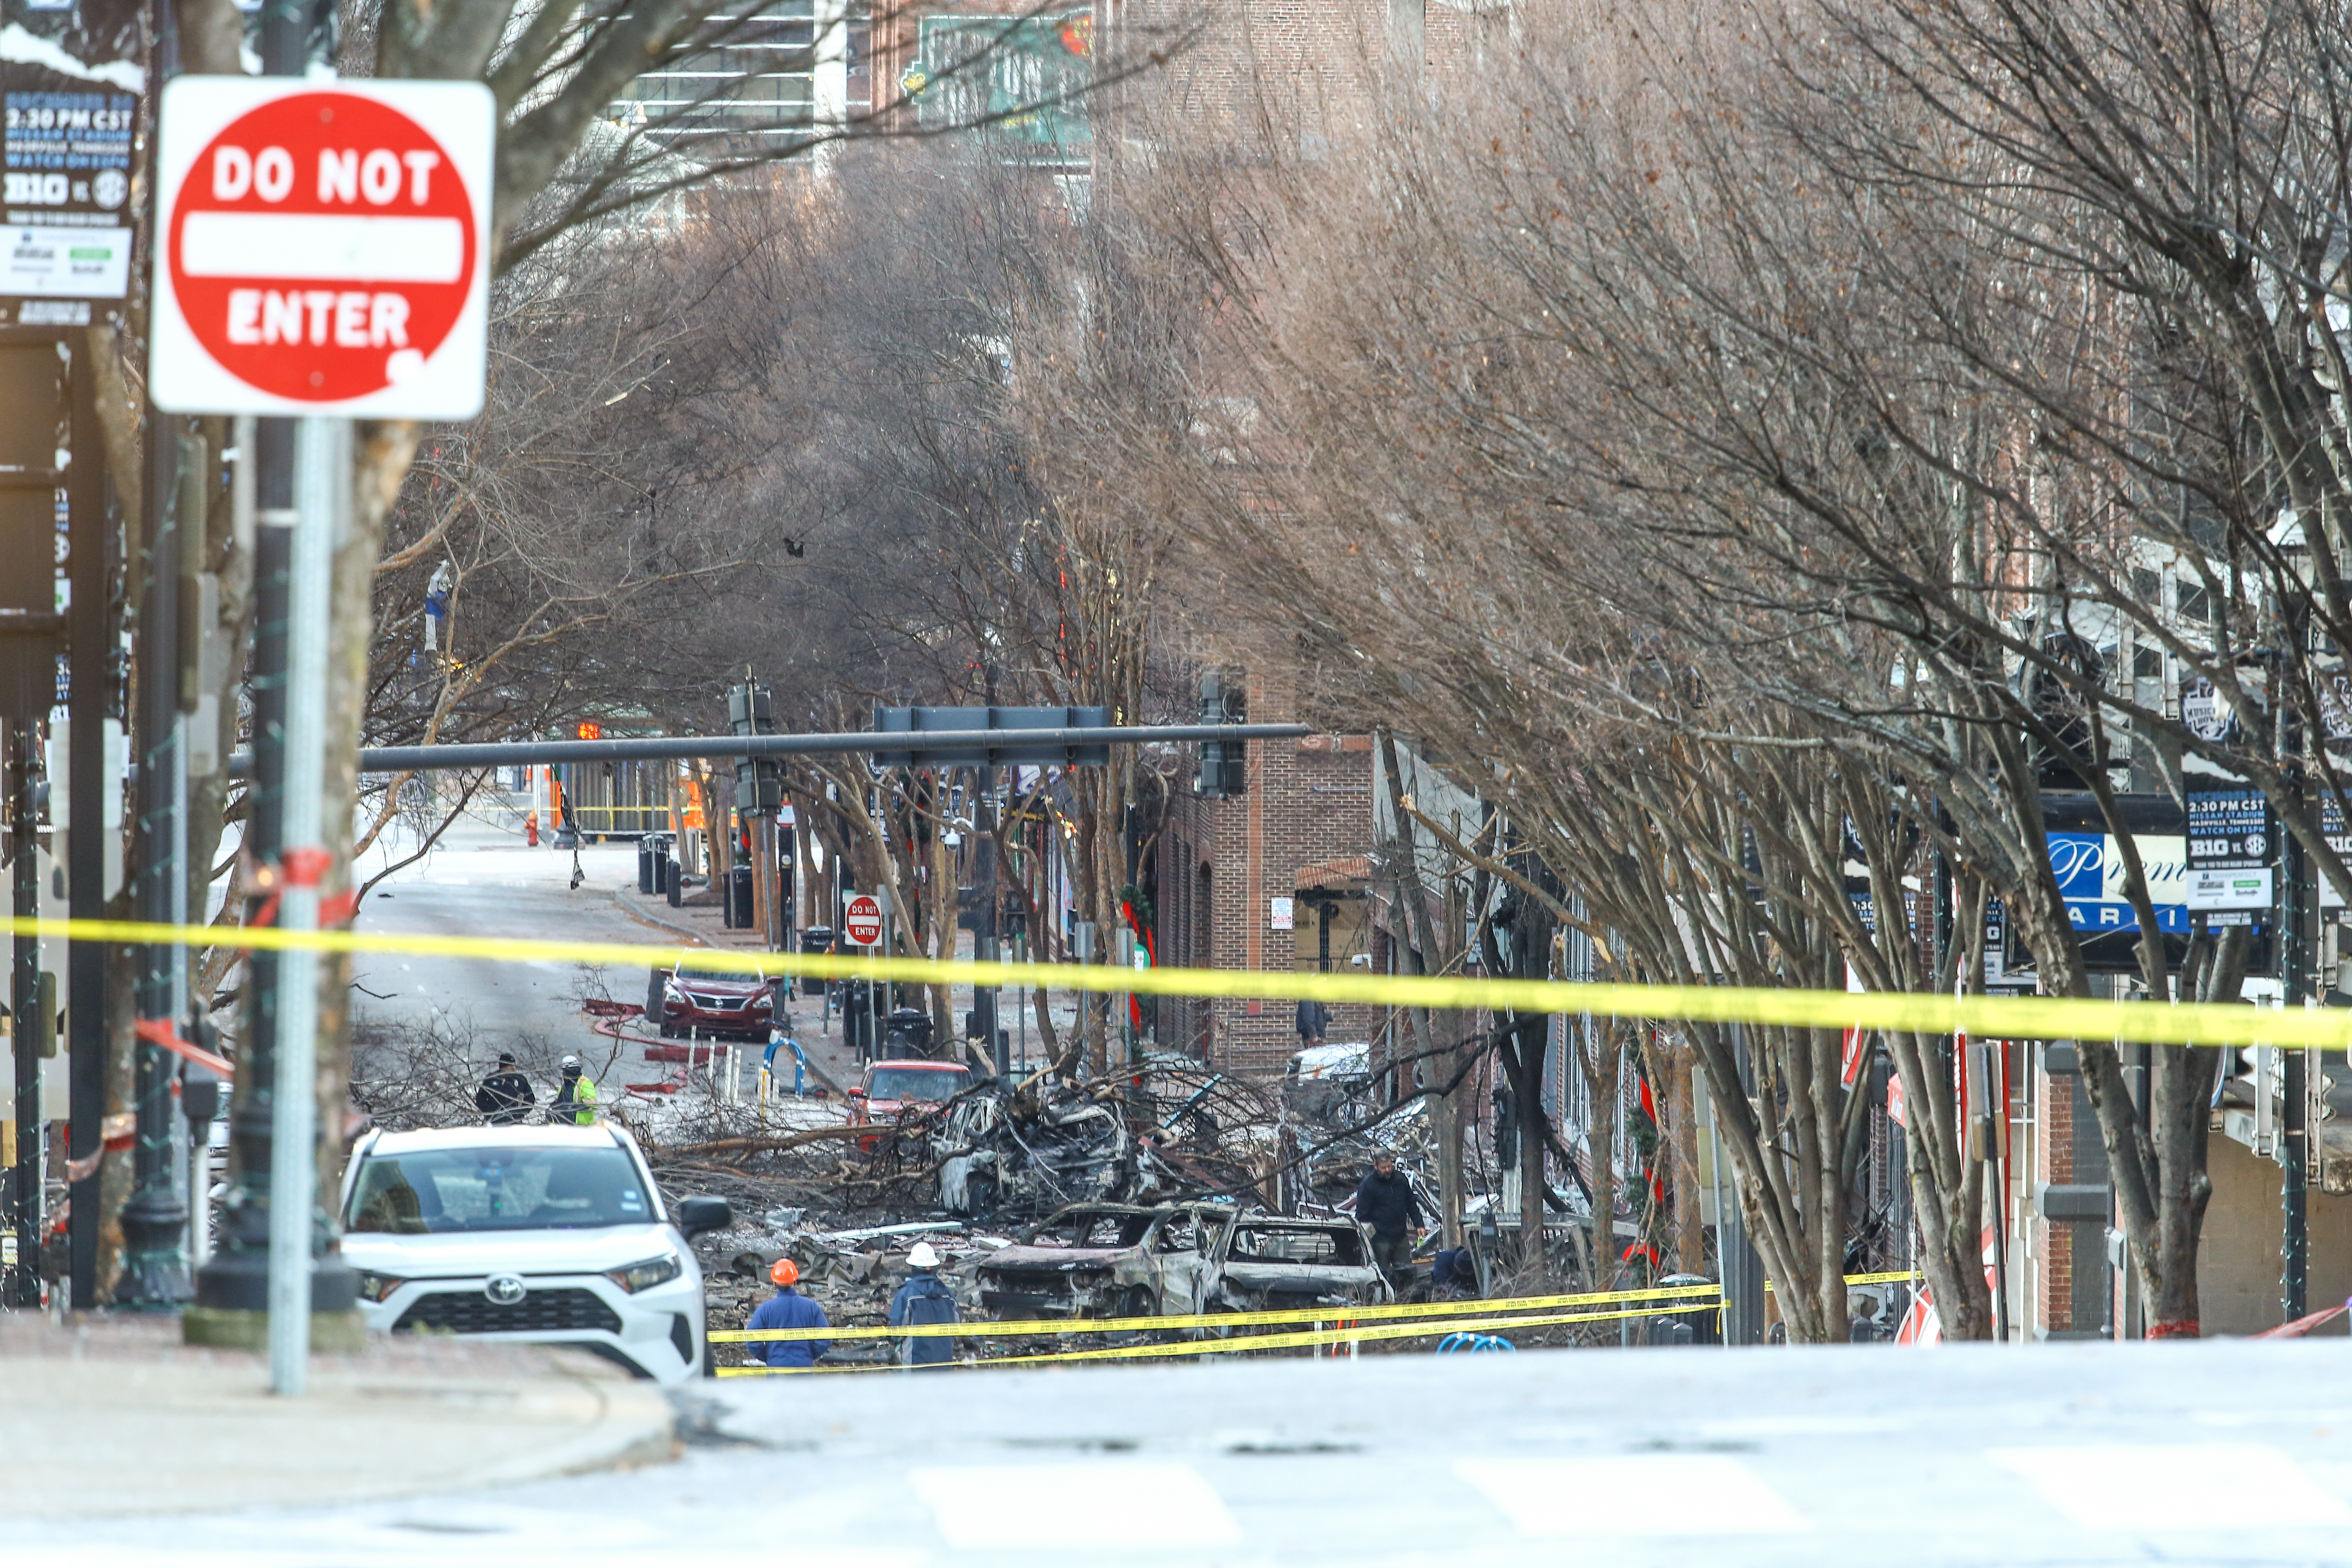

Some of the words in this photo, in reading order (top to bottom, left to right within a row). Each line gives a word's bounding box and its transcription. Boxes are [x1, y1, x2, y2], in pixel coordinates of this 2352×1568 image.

[212, 145, 293, 201] DO
[318, 148, 440, 205] NOT
[227, 289, 410, 347] ENTER
[2189, 801, 2217, 813] 2:30
[2220, 800, 2239, 811] PM
[2241, 799, 2265, 810] CST
[2190, 827, 2225, 835] WATCH
[852, 905, 862, 914] DO
[865, 905, 876, 914] NOT
[855, 926, 875, 936] ENTER
